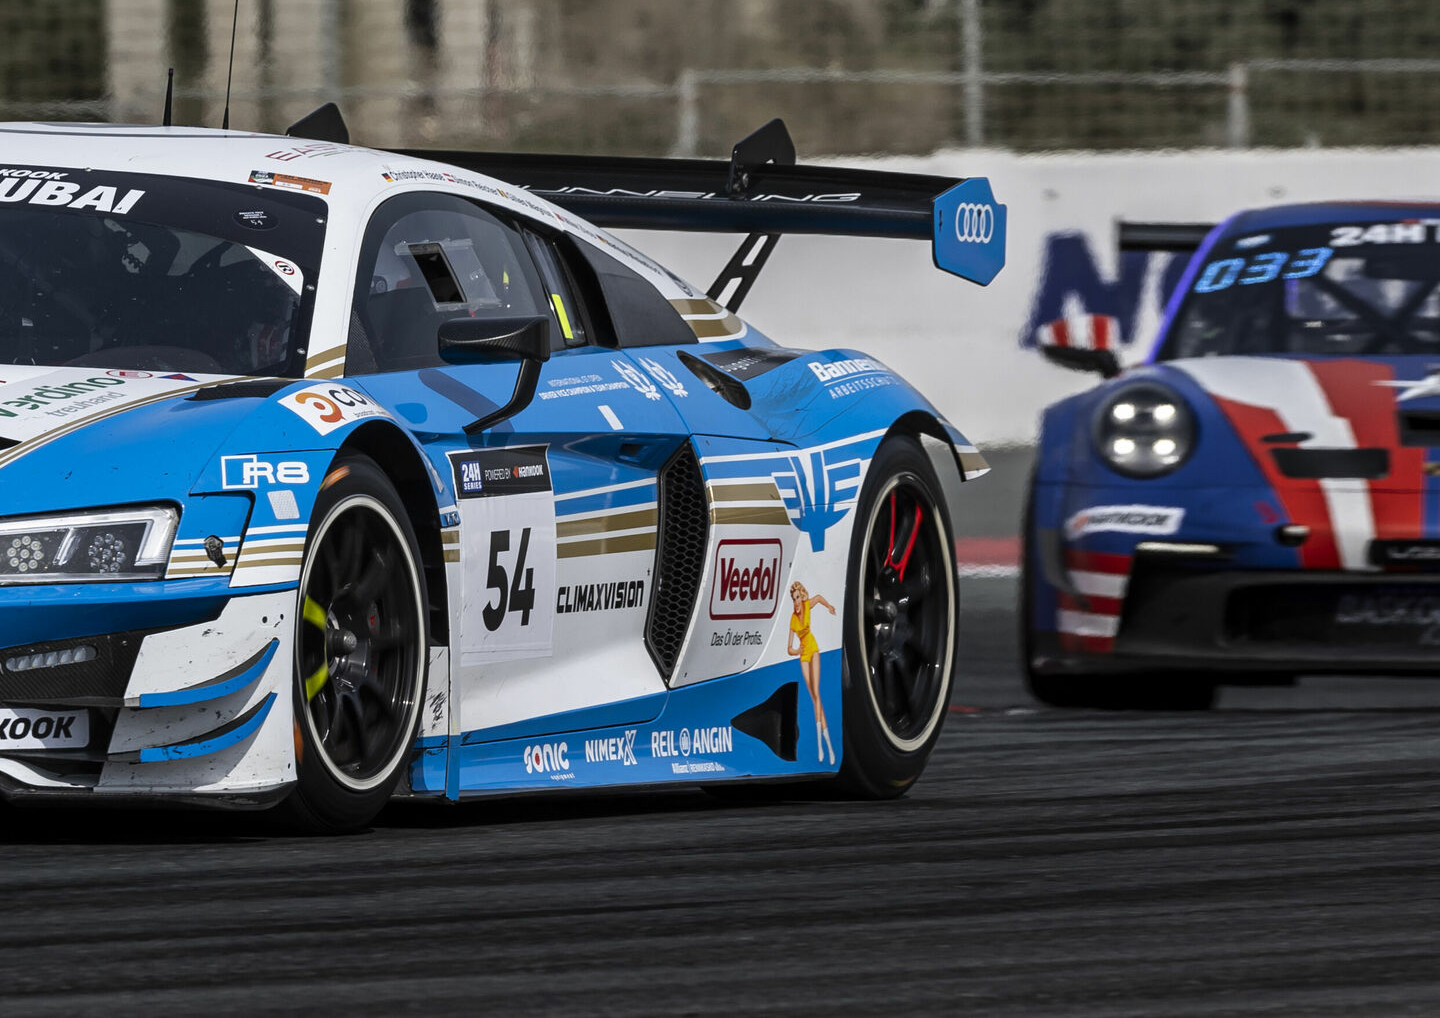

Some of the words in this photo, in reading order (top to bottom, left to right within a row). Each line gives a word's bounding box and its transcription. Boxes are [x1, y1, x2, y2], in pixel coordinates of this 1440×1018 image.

[1329, 225, 1427, 247] 24H
[1194, 247, 1334, 293] 033
[242, 461, 310, 484] R8
[462, 462, 481, 482] 24H
[485, 468, 505, 481] POWERED
[464, 482, 482, 490] SERIES
[482, 527, 536, 632] 54
[720, 558, 778, 601] Veedol
[711, 632, 723, 647] Das
[732, 632, 743, 646] der
[651, 731, 679, 758] REIL
[693, 726, 733, 754] ANGIN
